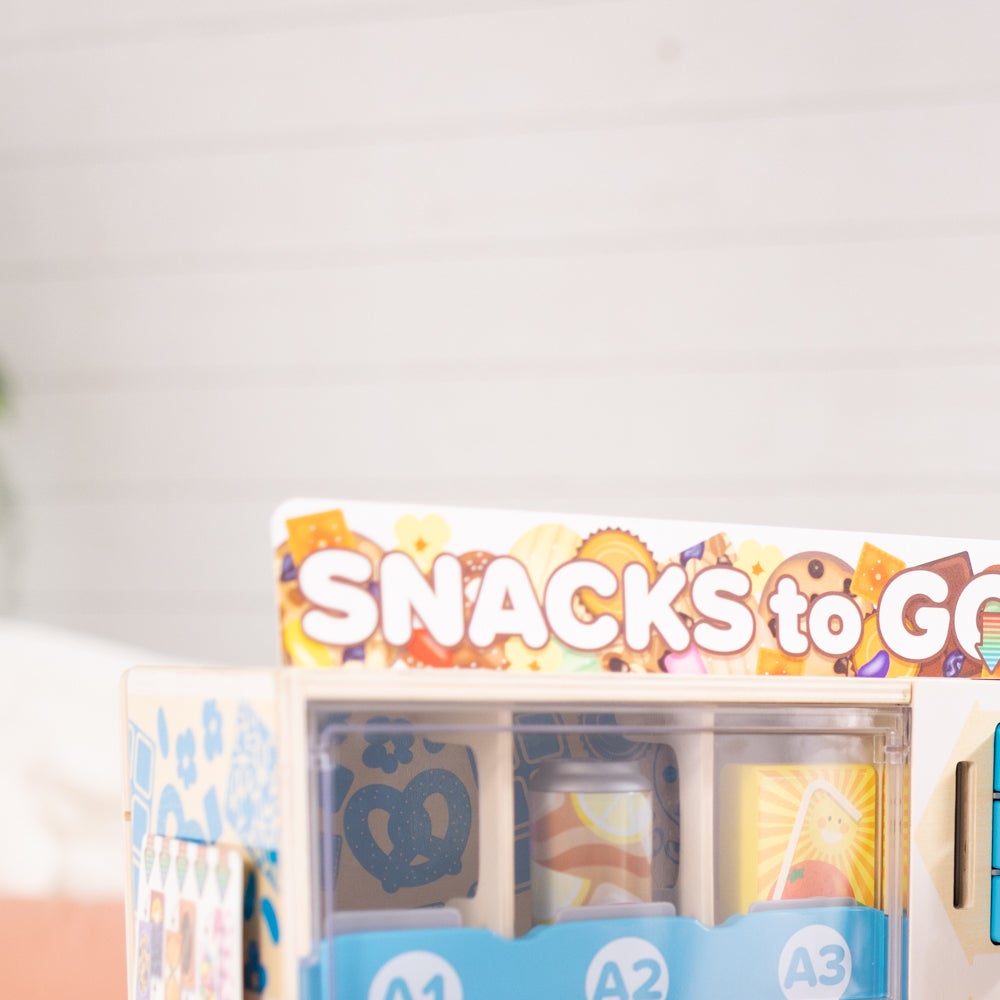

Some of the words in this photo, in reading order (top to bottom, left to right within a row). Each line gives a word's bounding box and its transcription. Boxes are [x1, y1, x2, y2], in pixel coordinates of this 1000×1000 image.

[298, 547, 756, 653] SNACKS
[768, 576, 863, 656] to
[783, 943, 847, 989] A3
